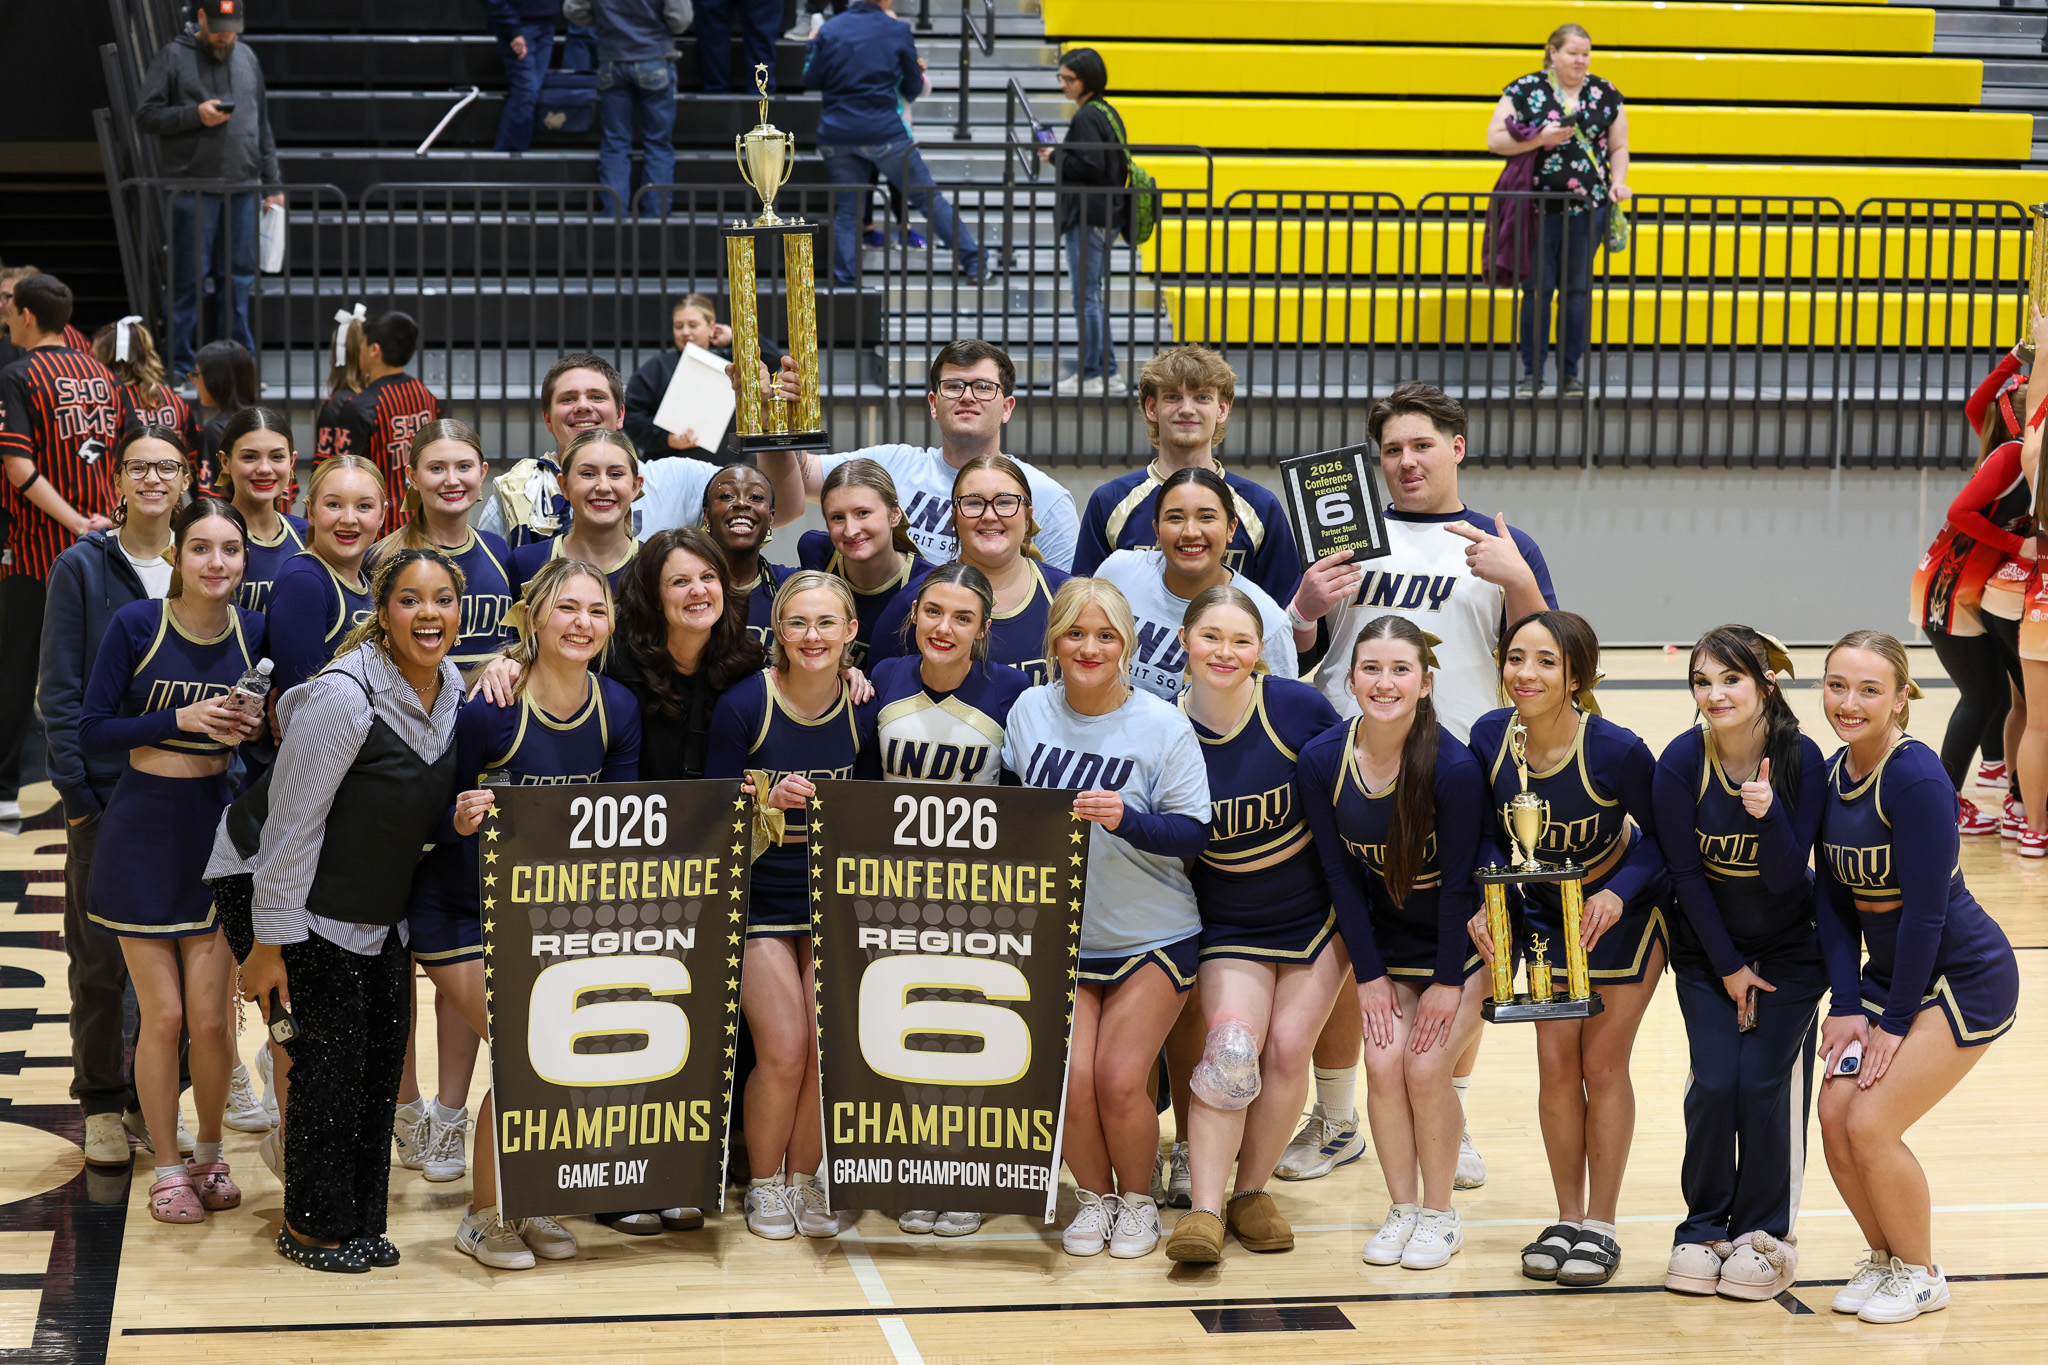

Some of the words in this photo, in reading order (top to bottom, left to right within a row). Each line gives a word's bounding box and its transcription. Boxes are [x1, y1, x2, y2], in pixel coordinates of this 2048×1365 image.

[55, 376, 110, 405] SHO
[55, 404, 117, 440] TIME
[1304, 472, 1353, 491] Conference
[1310, 460, 1343, 477] 2026
[1314, 484, 1348, 497] REGION
[1315, 492, 1354, 527] 6
[1317, 539, 1369, 557] CHAMPIONS
[1321, 525, 1341, 538] Partner
[1342, 523, 1358, 533] Stunt
[1333, 534, 1350, 544] COED
[1349, 570, 1461, 613] INDY
[887, 736, 991, 784] INDY
[569, 793, 667, 849] 2026
[893, 794, 998, 850] 2026
[1209, 782, 1291, 841] NDY
[510, 858, 721, 903] CONFERENCE
[836, 857, 1057, 904] CONFERENCE
[531, 928, 696, 957] REGION
[858, 927, 1032, 956] REGION
[1529, 933, 1550, 951] 3rd
[527, 955, 692, 1087] 6
[858, 954, 1032, 1086] 6
[502, 1100, 711, 1154] CHAMPIONS
[833, 1101, 1053, 1152] CHAMPIONS
[557, 1162, 610, 1190] GAME
[614, 1159, 649, 1186] DAY
[833, 1158, 893, 1184] GRAND
[897, 1159, 990, 1187] CHAMPION
[995, 1163, 1050, 1192] CHEER
